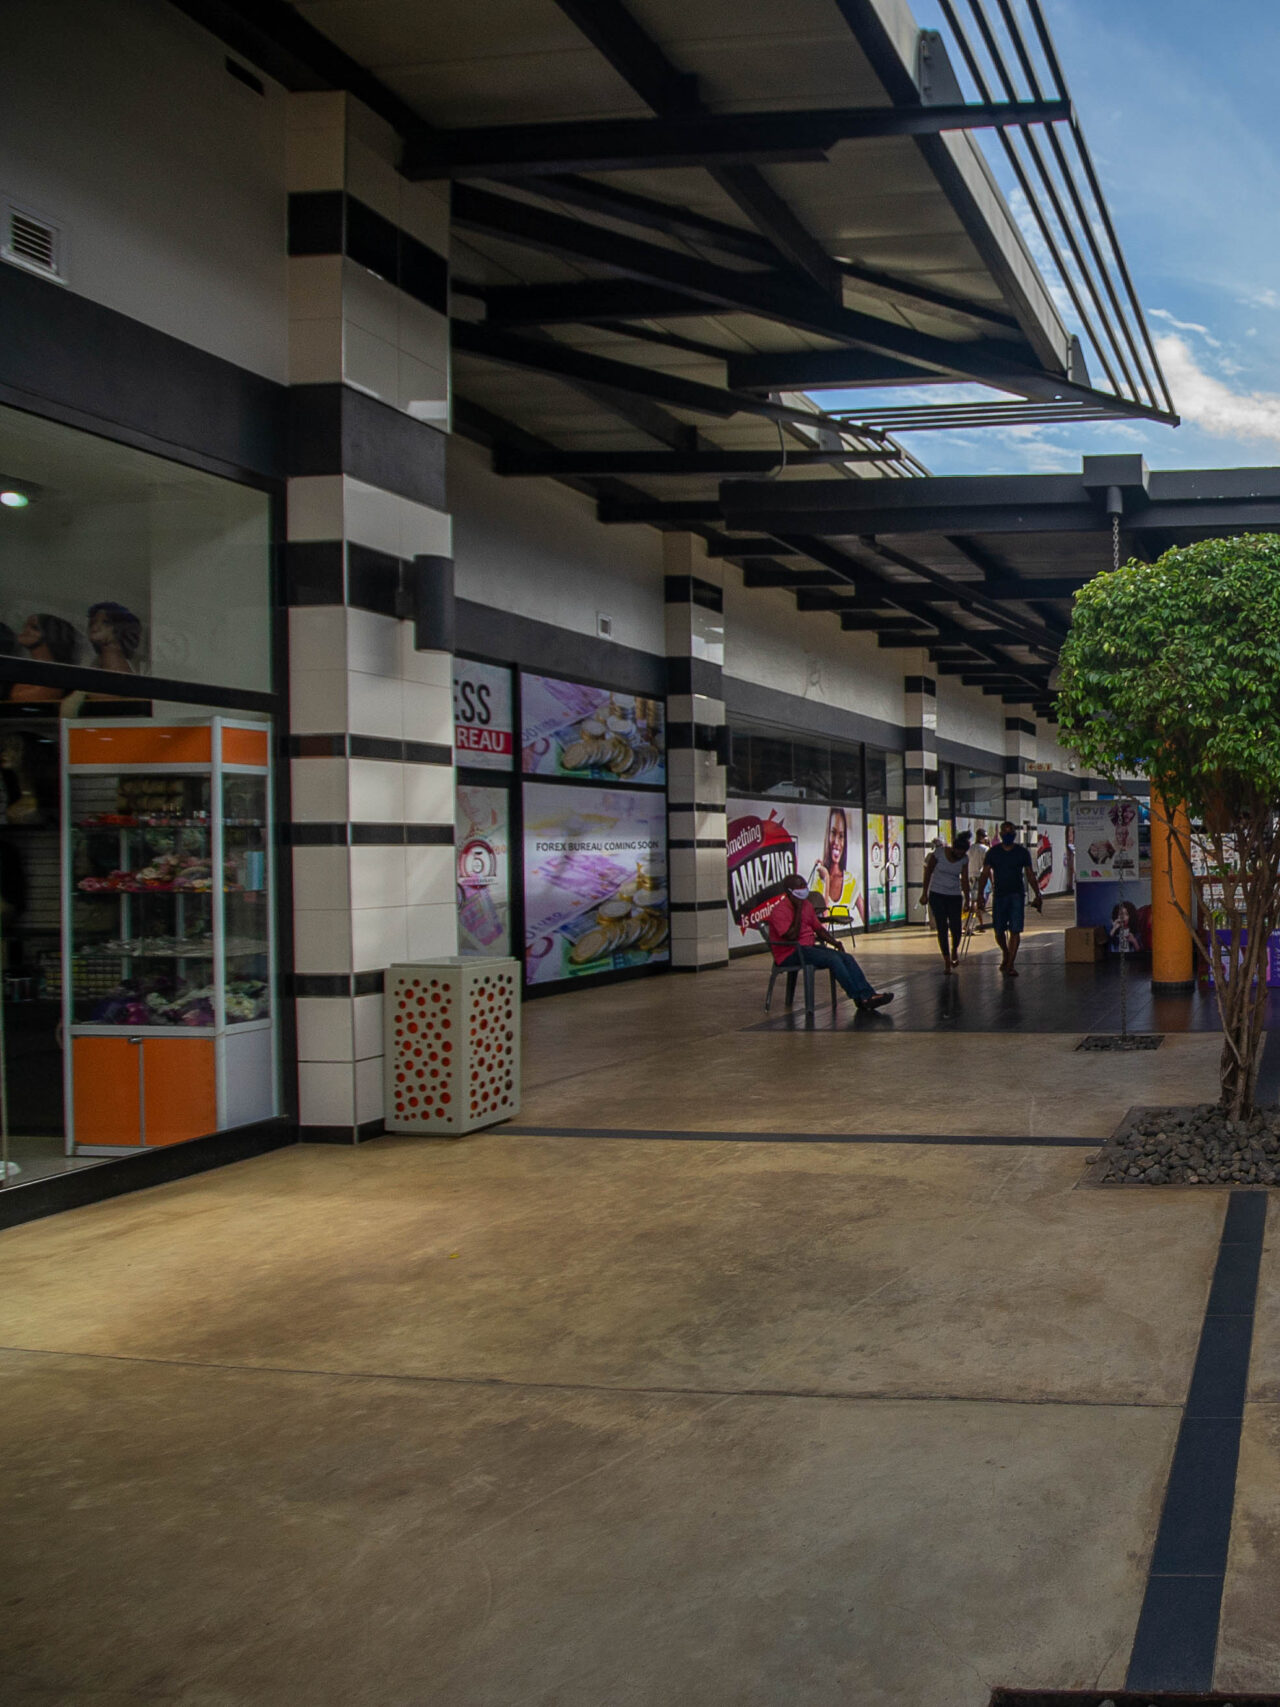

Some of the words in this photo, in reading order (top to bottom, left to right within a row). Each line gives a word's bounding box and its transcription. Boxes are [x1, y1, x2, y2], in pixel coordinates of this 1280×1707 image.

[536, 842, 566, 851] FOREX
[569, 842, 601, 851] BUREAU
[604, 841, 636, 851] COMING
[637, 840, 659, 850] SOON
[731, 850, 794, 911] AMAZING
[741, 914, 750, 928] is
